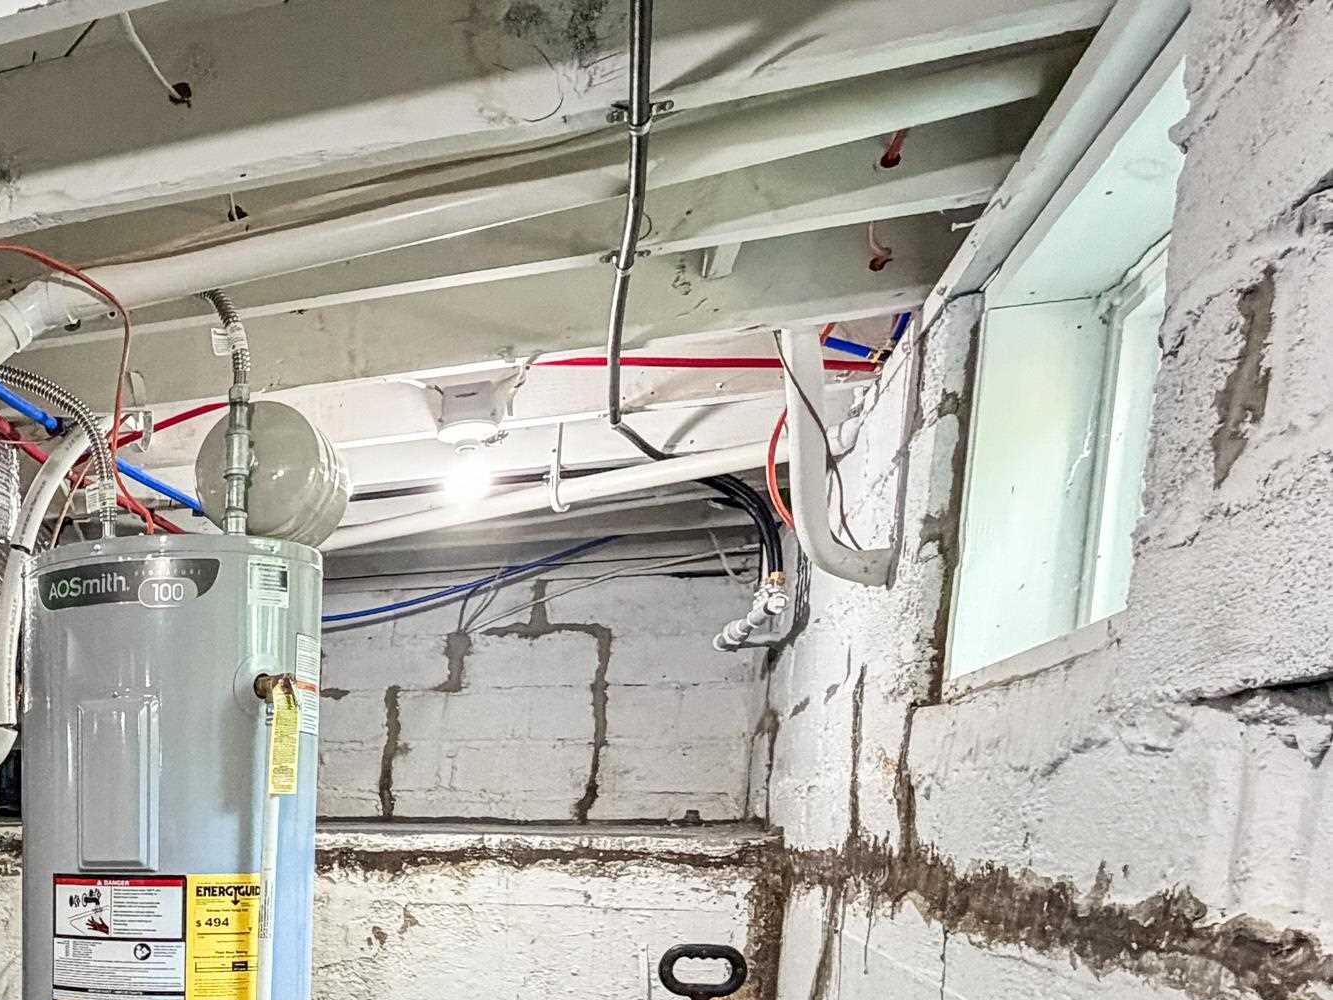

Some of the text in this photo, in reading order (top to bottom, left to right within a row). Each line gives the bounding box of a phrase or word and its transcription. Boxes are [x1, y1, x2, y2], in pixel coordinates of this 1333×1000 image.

[151, 583, 184, 601] 100
[195, 885, 261, 898] ENERGYGUID
[204, 917, 230, 928] 494
